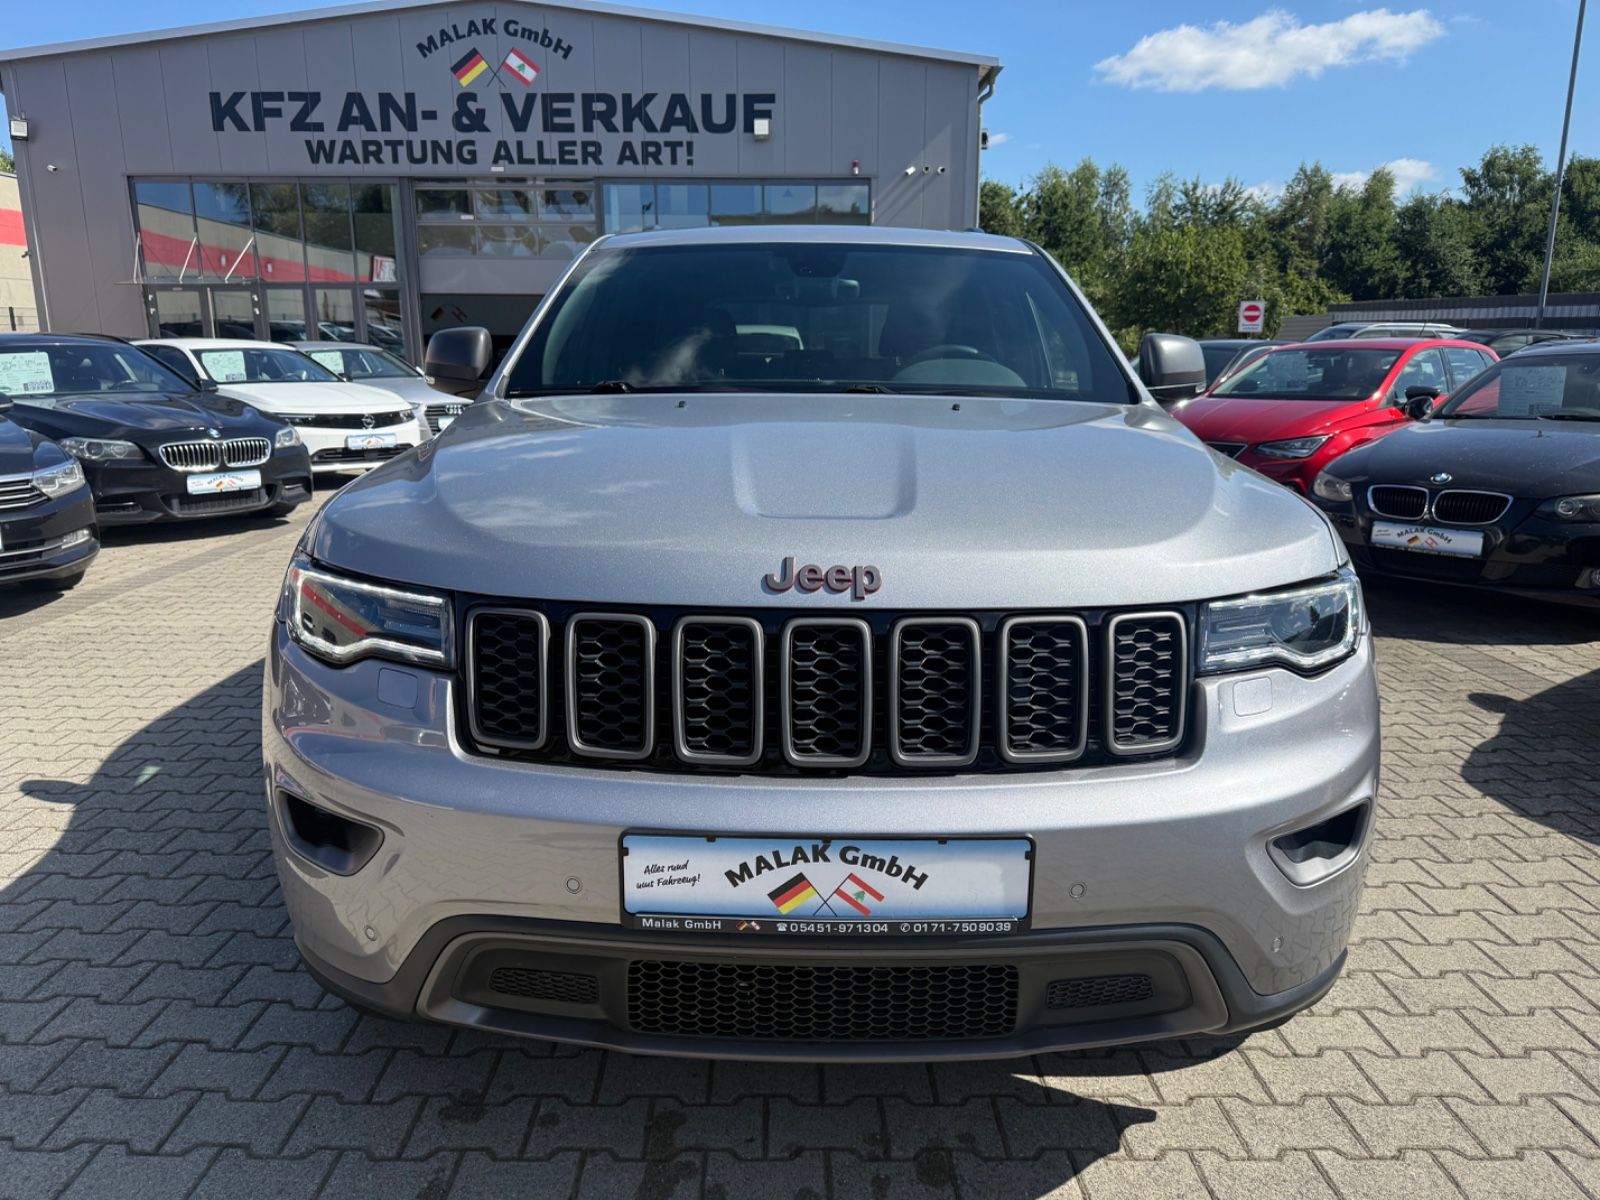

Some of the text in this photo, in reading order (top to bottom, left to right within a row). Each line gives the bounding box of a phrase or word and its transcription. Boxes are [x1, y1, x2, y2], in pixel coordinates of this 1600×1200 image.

[416, 18, 573, 60] MALAK GmbH
[209, 91, 776, 134] KFZ AN- & VERKAUF
[305, 139, 694, 166] WARTUNG ALLER ART!
[762, 556, 882, 601] Jeep
[644, 859, 690, 875] Alles rund
[657, 873, 701, 887] Fahrzeug!
[724, 844, 929, 890] MALAK GmbH
[642, 918, 1012, 933] Malak GmbH 05451-971304 0171-7509039
